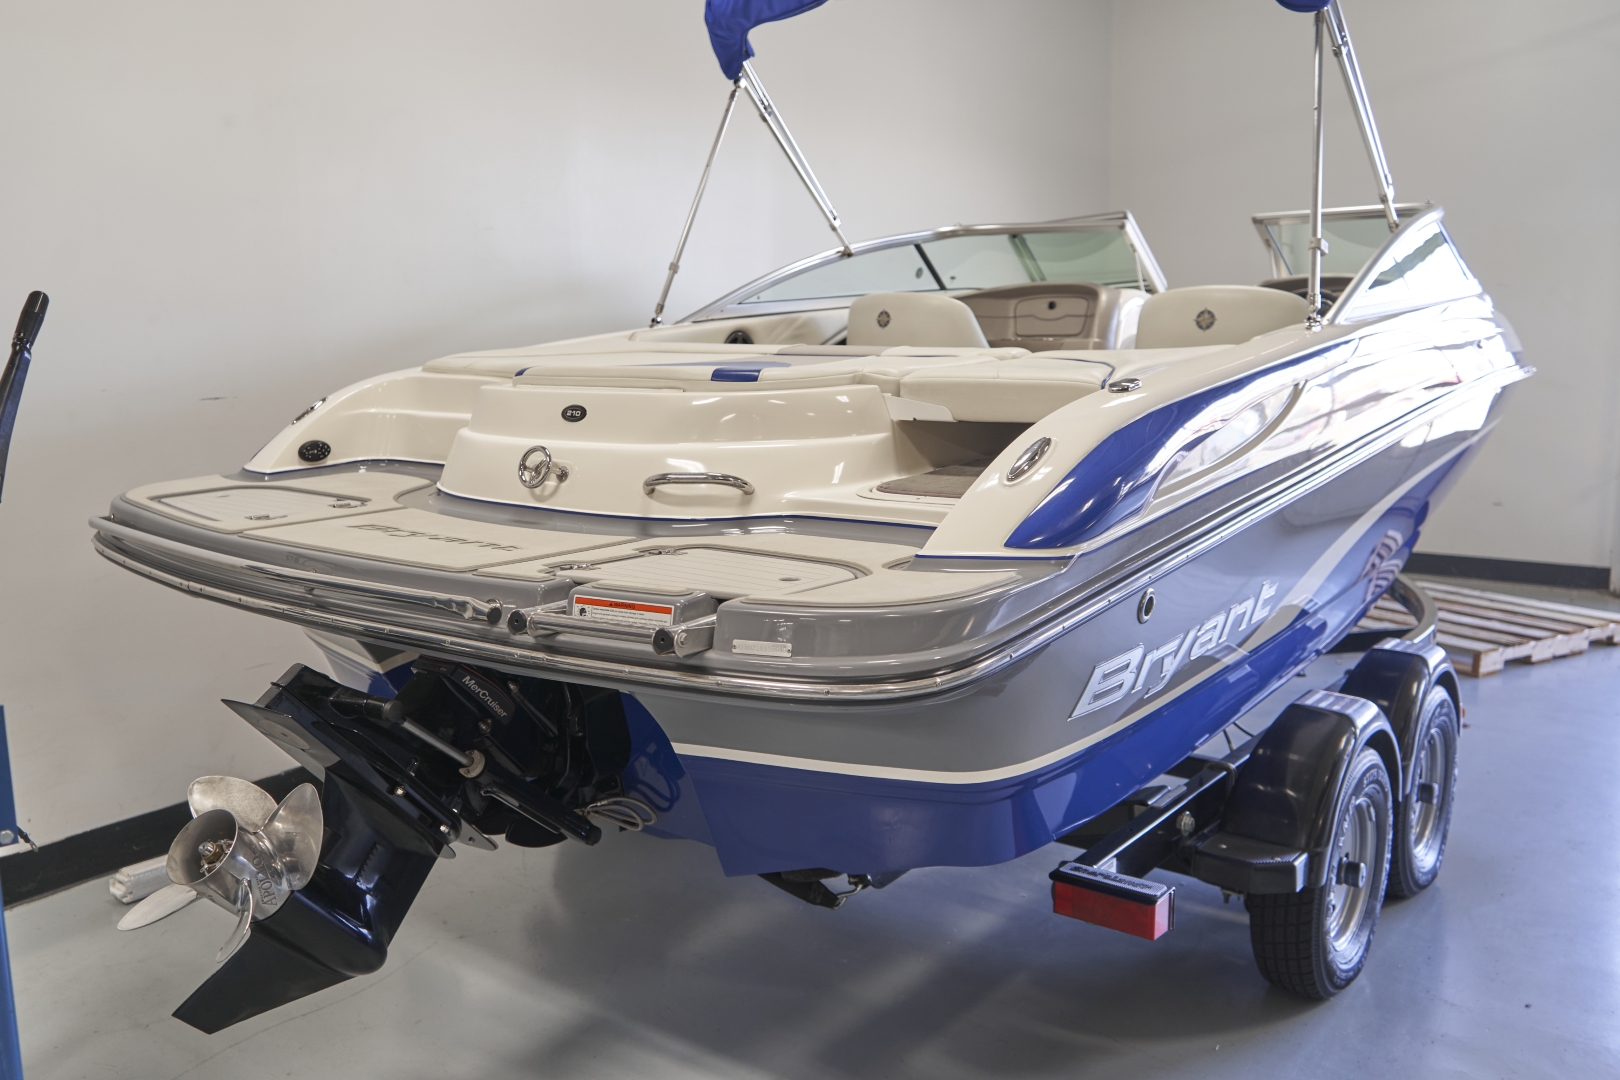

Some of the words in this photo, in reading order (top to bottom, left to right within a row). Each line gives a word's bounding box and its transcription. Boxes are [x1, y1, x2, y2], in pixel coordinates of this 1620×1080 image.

[566, 409, 581, 417] 210
[613, 602, 636, 610] WARNING
[1066, 579, 1279, 722] Bryant
[461, 675, 508, 718] MerCruiser
